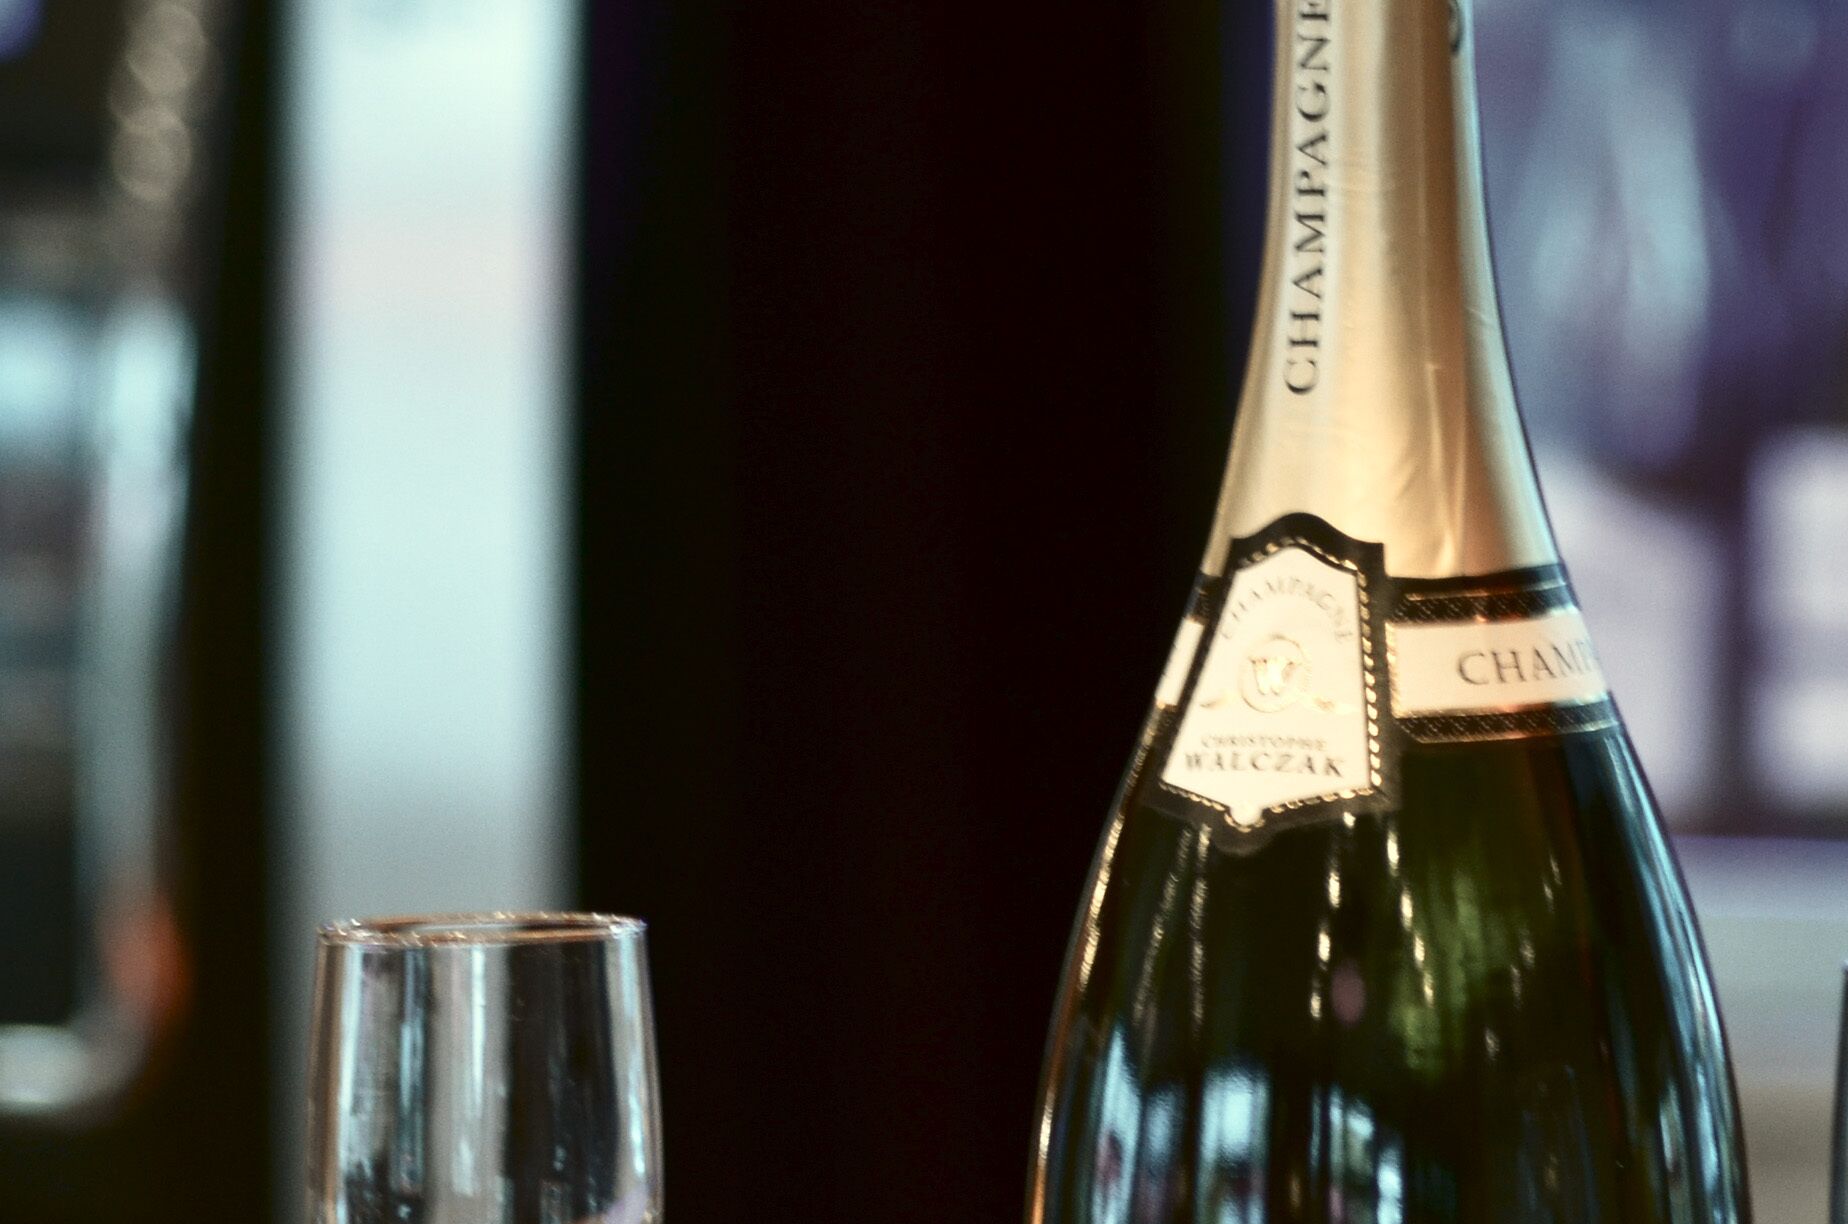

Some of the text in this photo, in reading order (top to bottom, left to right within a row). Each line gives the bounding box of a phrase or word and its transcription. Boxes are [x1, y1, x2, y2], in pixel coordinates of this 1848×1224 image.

[1284, 0, 1331, 395] CHAMPAGNE
[1201, 736, 1327, 752] CHRISTOPHE
[1186, 751, 1344, 777] WALCZAK
